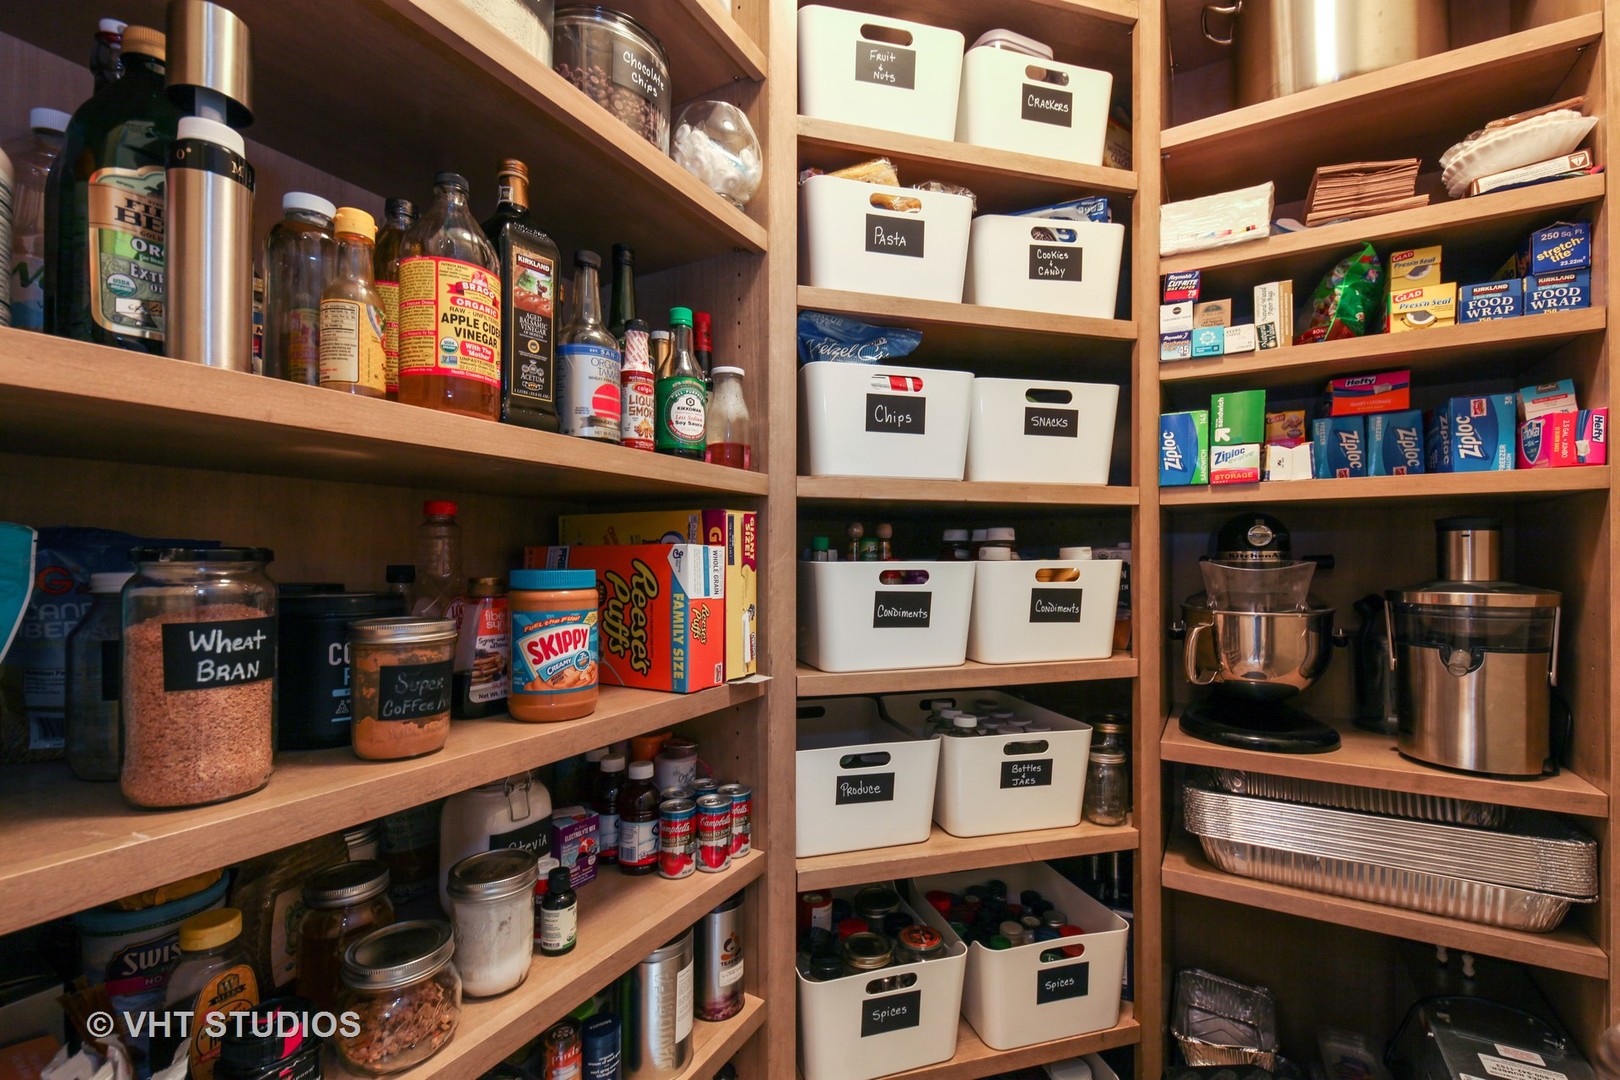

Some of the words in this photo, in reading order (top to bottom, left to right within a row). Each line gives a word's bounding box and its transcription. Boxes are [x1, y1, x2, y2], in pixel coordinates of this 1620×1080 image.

[869, 50, 896, 63] Fruit
[623, 50, 665, 92] Chocolate
[873, 71, 896, 83] Nuts
[631, 71, 658, 97] Chips
[874, 226, 907, 247] PASTA
[1540, 231, 1559, 241] 250
[517, 255, 550, 272] KIRKLAND
[1037, 249, 1069, 261] Cookies
[1392, 252, 1414, 261] GLAD
[1538, 274, 1576, 283] KIRKLAND
[461, 281, 496, 299] BRAGG
[1395, 290, 1422, 302] GLAD
[1473, 283, 1509, 293] KIRKLAND
[1532, 287, 1581, 301] FOOD
[456, 298, 497, 318] ORGANIC
[1466, 305, 1515, 318] WRAP
[1468, 297, 1514, 310] FOOD
[1530, 296, 1582, 310] WRAP
[441, 312, 480, 330] APPLE
[454, 326, 498, 349] VINEGAR
[1347, 376, 1375, 387] Hefty
[874, 404, 912, 427] Chips
[1456, 415, 1483, 459] Ziploc
[1594, 415, 1604, 441] Hefty
[1162, 431, 1183, 471] Ziploc
[1214, 447, 1246, 465] Ziploc
[1339, 430, 1362, 469] Ziploc
[1397, 427, 1421, 467] Ziploc
[1214, 472, 1253, 480] STORAGE
[601, 569, 630, 659] Puffs
[877, 604, 928, 619] Condiments
[1034, 599, 1080, 614] Condiments
[631, 558, 659, 677] Reese's
[672, 593, 684, 645] FAMILY
[189, 629, 266, 654] Wheat
[527, 628, 588, 665] SKIPPY
[546, 657, 572, 675] CREAMY
[672, 648, 684, 680] SIZE
[1011, 763, 1042, 774] Bottles
[840, 781, 882, 797] Produce
[1044, 976, 1076, 992] Spices
[872, 1004, 908, 1023] Spices
